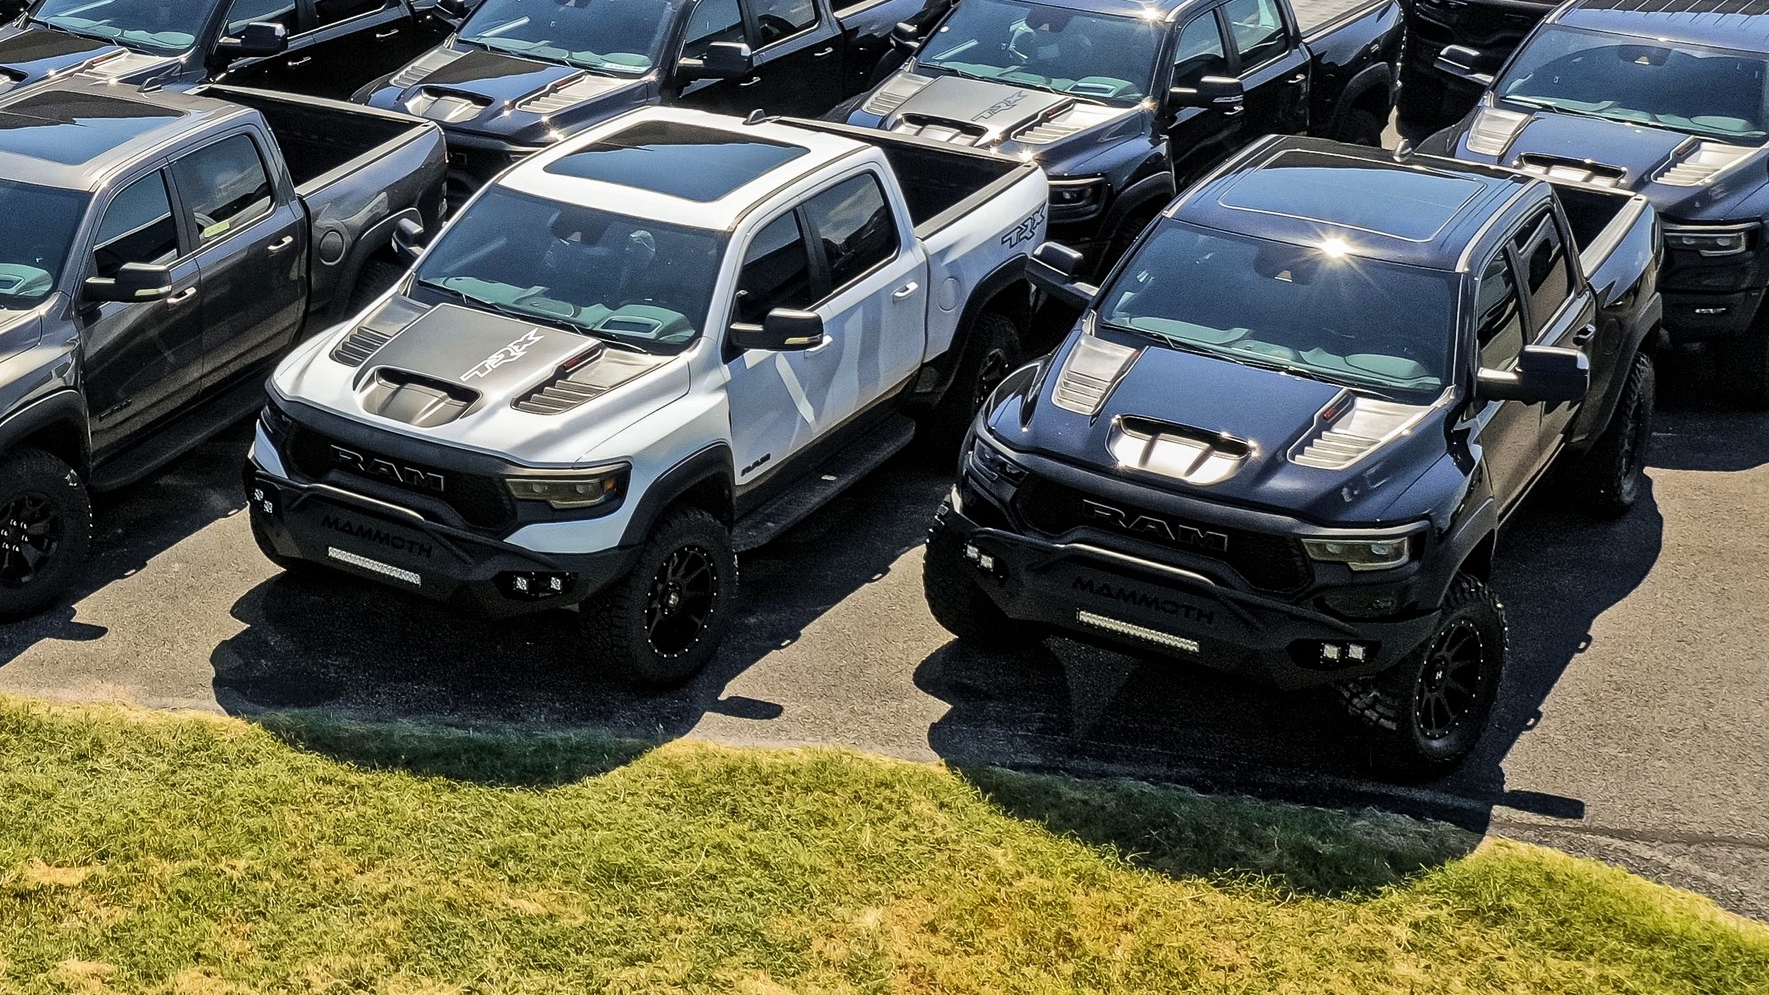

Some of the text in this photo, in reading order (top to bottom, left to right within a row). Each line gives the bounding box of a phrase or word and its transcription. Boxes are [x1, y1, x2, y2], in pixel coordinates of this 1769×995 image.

[1000, 200, 1047, 249] TRX
[459, 326, 545, 383] TRX
[329, 443, 445, 493] RAM
[321, 514, 434, 559] MAMMOTH
[1081, 498, 1229, 553] RAM
[1071, 574, 1216, 626] MAMMOTH
